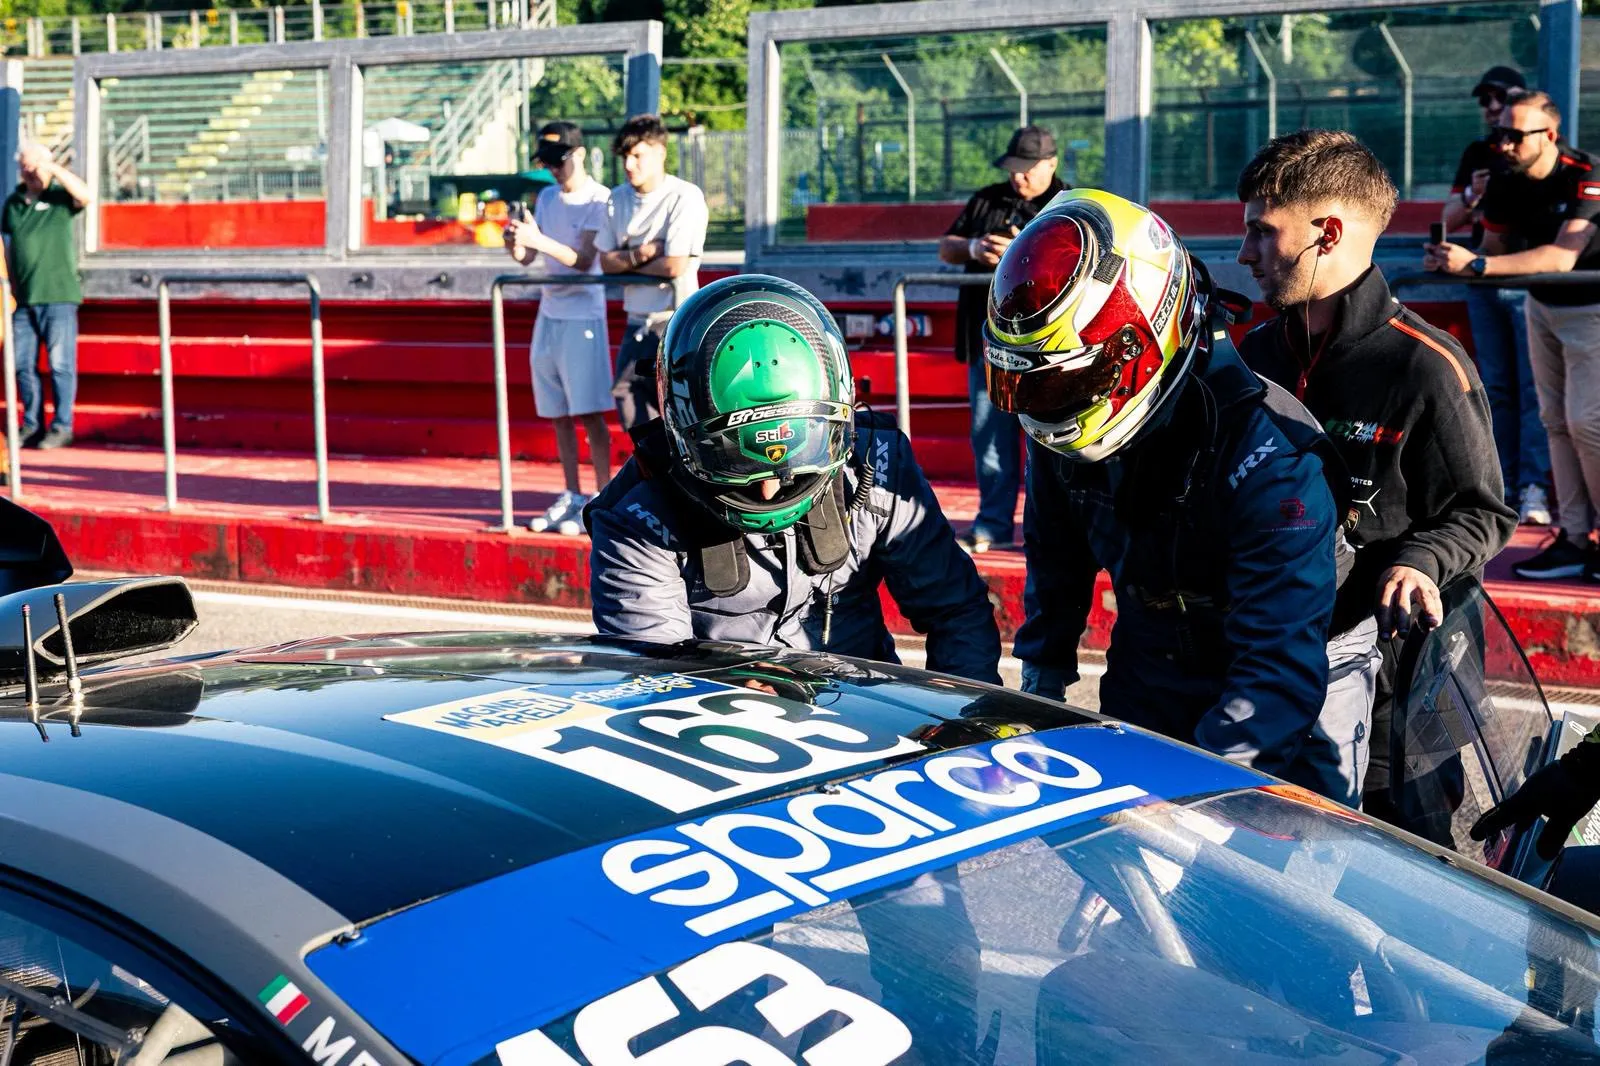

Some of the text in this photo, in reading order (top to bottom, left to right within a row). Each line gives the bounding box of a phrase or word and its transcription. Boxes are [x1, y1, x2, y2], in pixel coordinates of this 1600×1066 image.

[756, 423, 795, 443] Stilo
[1229, 437, 1278, 489] HRX
[544, 691, 899, 792] 163
[602, 742, 1102, 906] sparco
